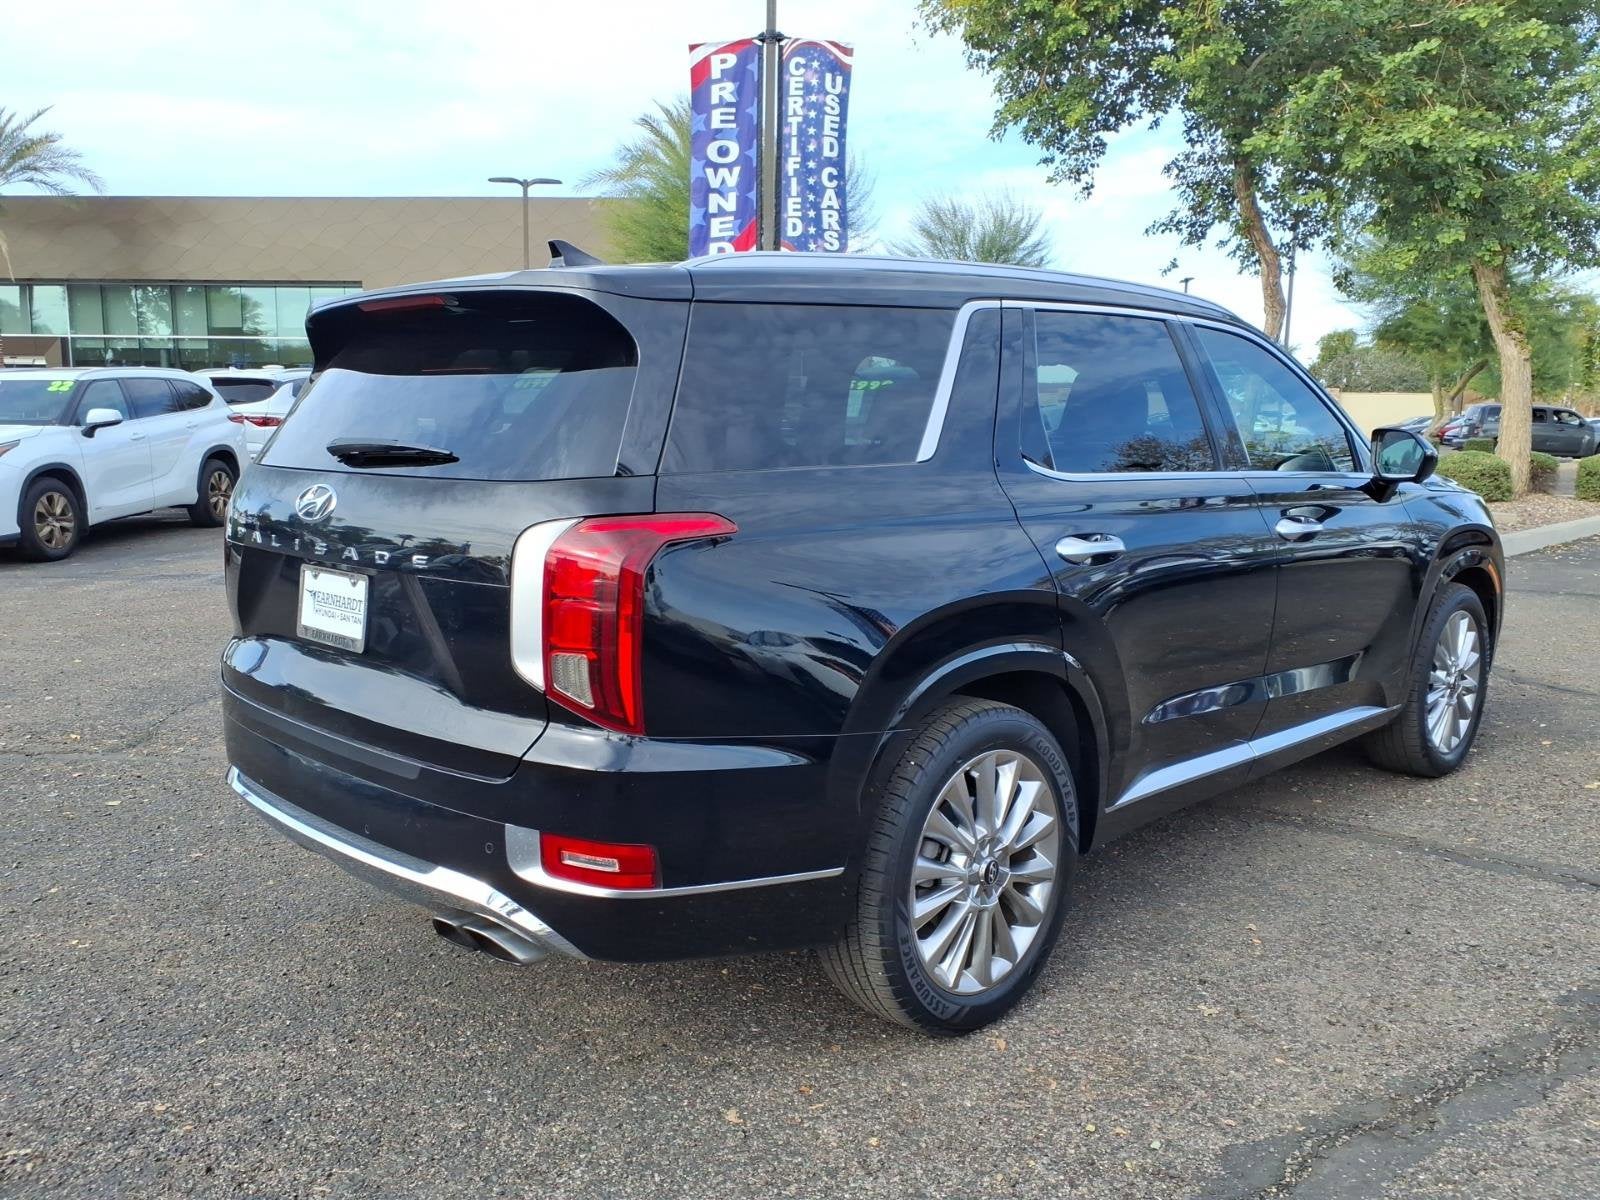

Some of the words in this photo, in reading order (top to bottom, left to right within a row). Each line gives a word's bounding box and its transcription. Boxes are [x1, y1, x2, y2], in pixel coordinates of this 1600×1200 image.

[786, 56, 806, 237] CERTIFIED
[822, 72, 843, 158] USED
[820, 166, 840, 251] CARS
[236, 526, 429, 569] PALISADE
[315, 590, 364, 612] EARNHARDT
[1036, 739, 1077, 822] GOODYEAR
[900, 934, 949, 1016] ASSURANCE
